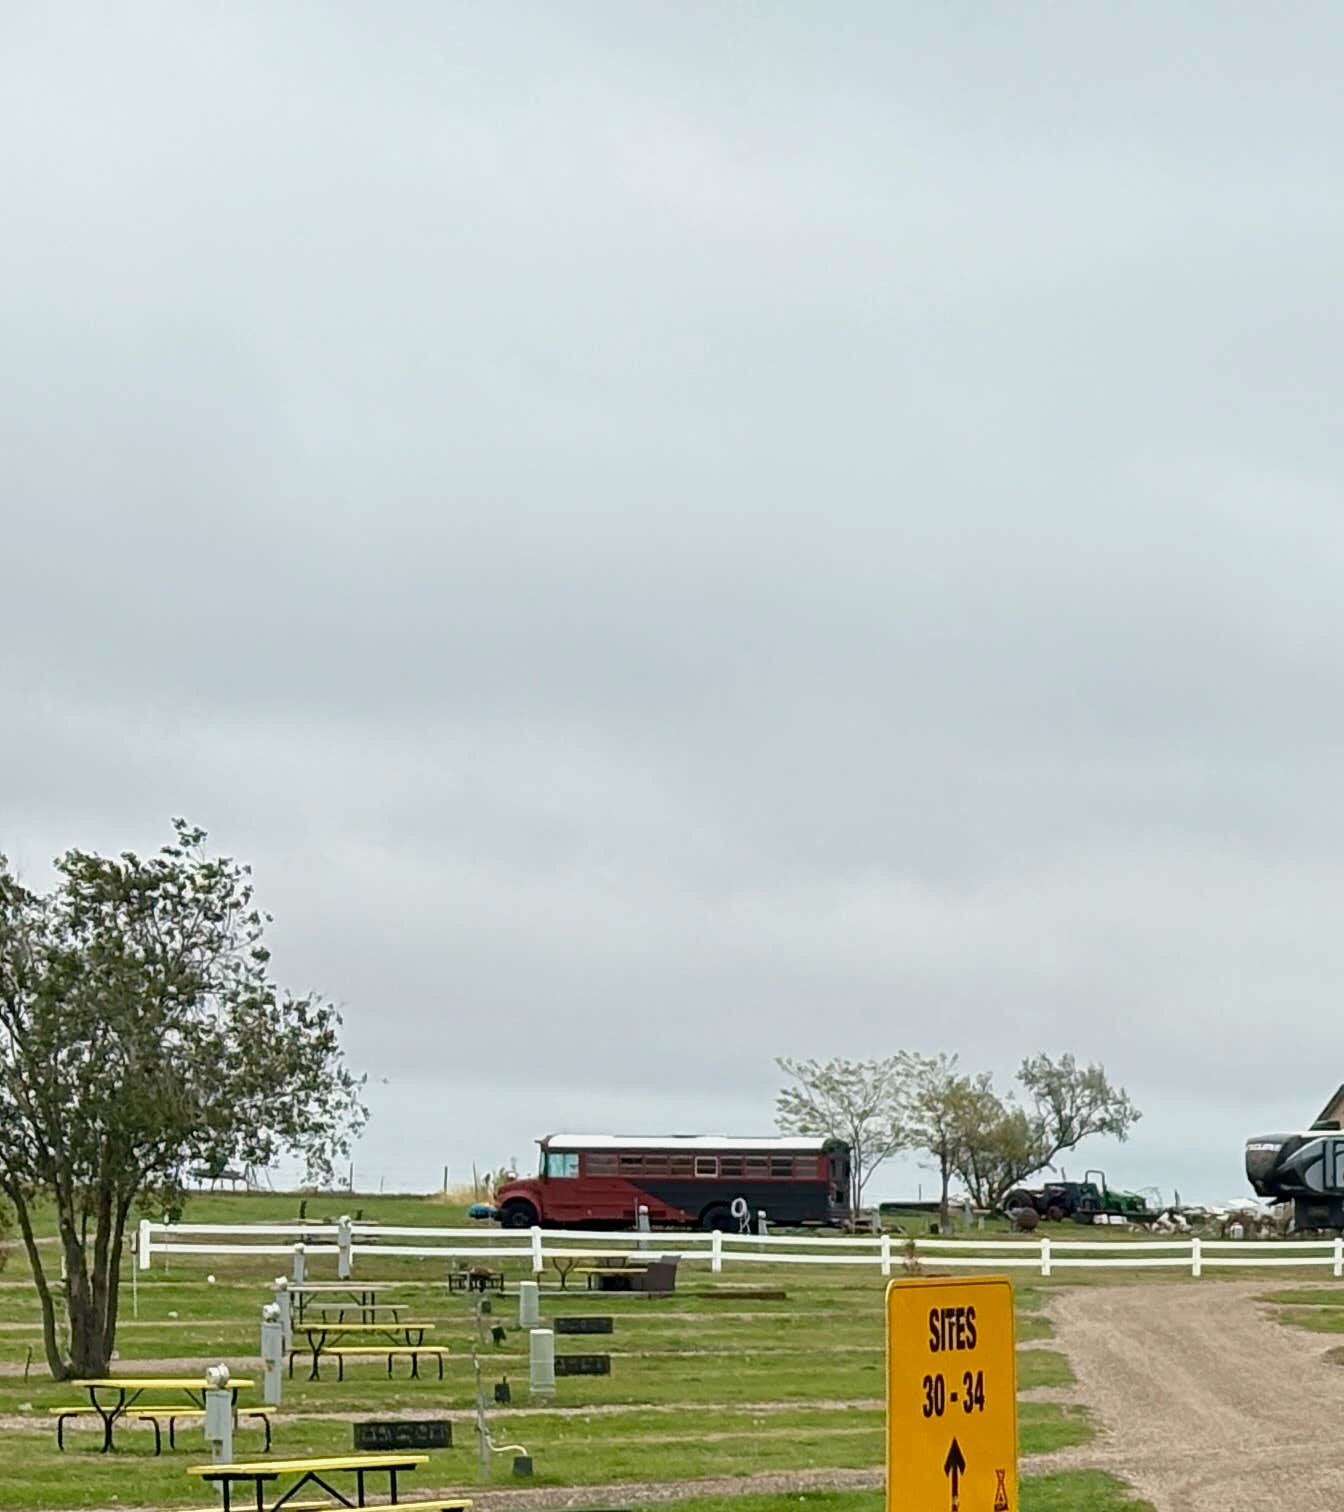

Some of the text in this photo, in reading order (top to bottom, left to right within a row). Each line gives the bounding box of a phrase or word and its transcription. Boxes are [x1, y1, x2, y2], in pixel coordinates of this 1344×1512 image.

[928, 1306, 977, 1352] SITES
[923, 1373, 945, 1418] 30
[963, 1370, 985, 1414] 34
